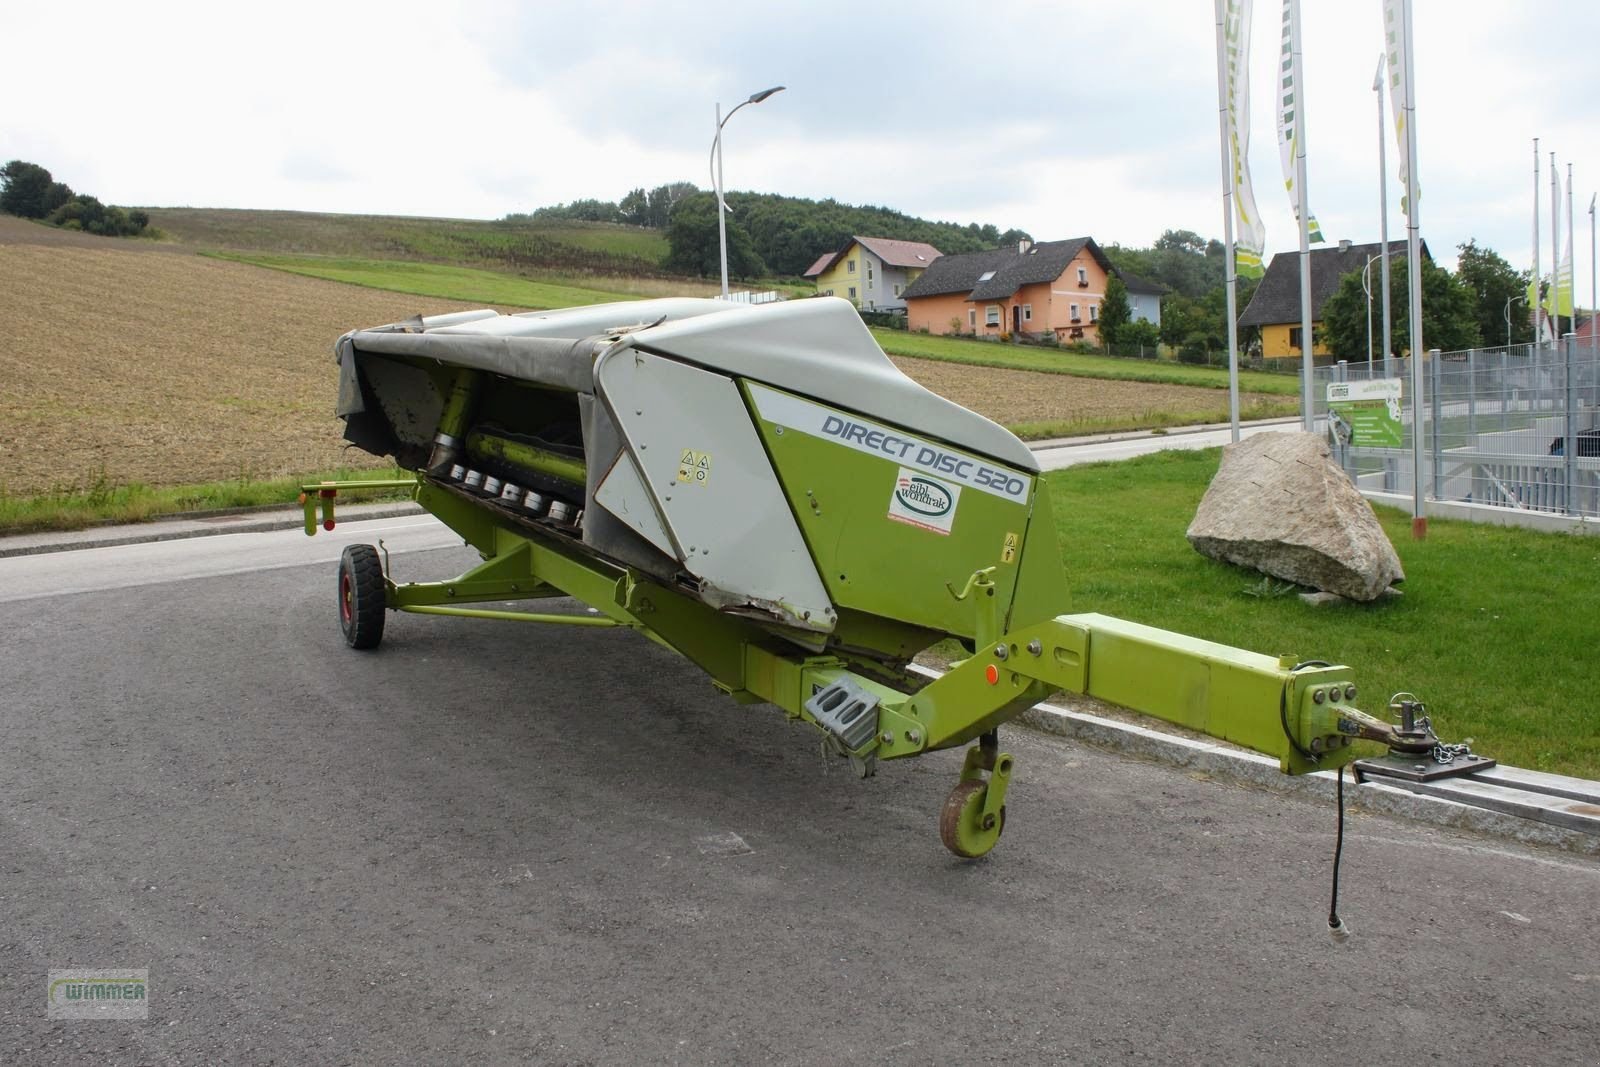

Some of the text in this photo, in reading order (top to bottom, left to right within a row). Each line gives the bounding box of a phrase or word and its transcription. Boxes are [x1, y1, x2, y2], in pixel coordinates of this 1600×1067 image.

[821, 416, 1024, 495] DIRECT DISC 520
[901, 488, 945, 510] wondrak
[909, 483, 929, 496] eibl
